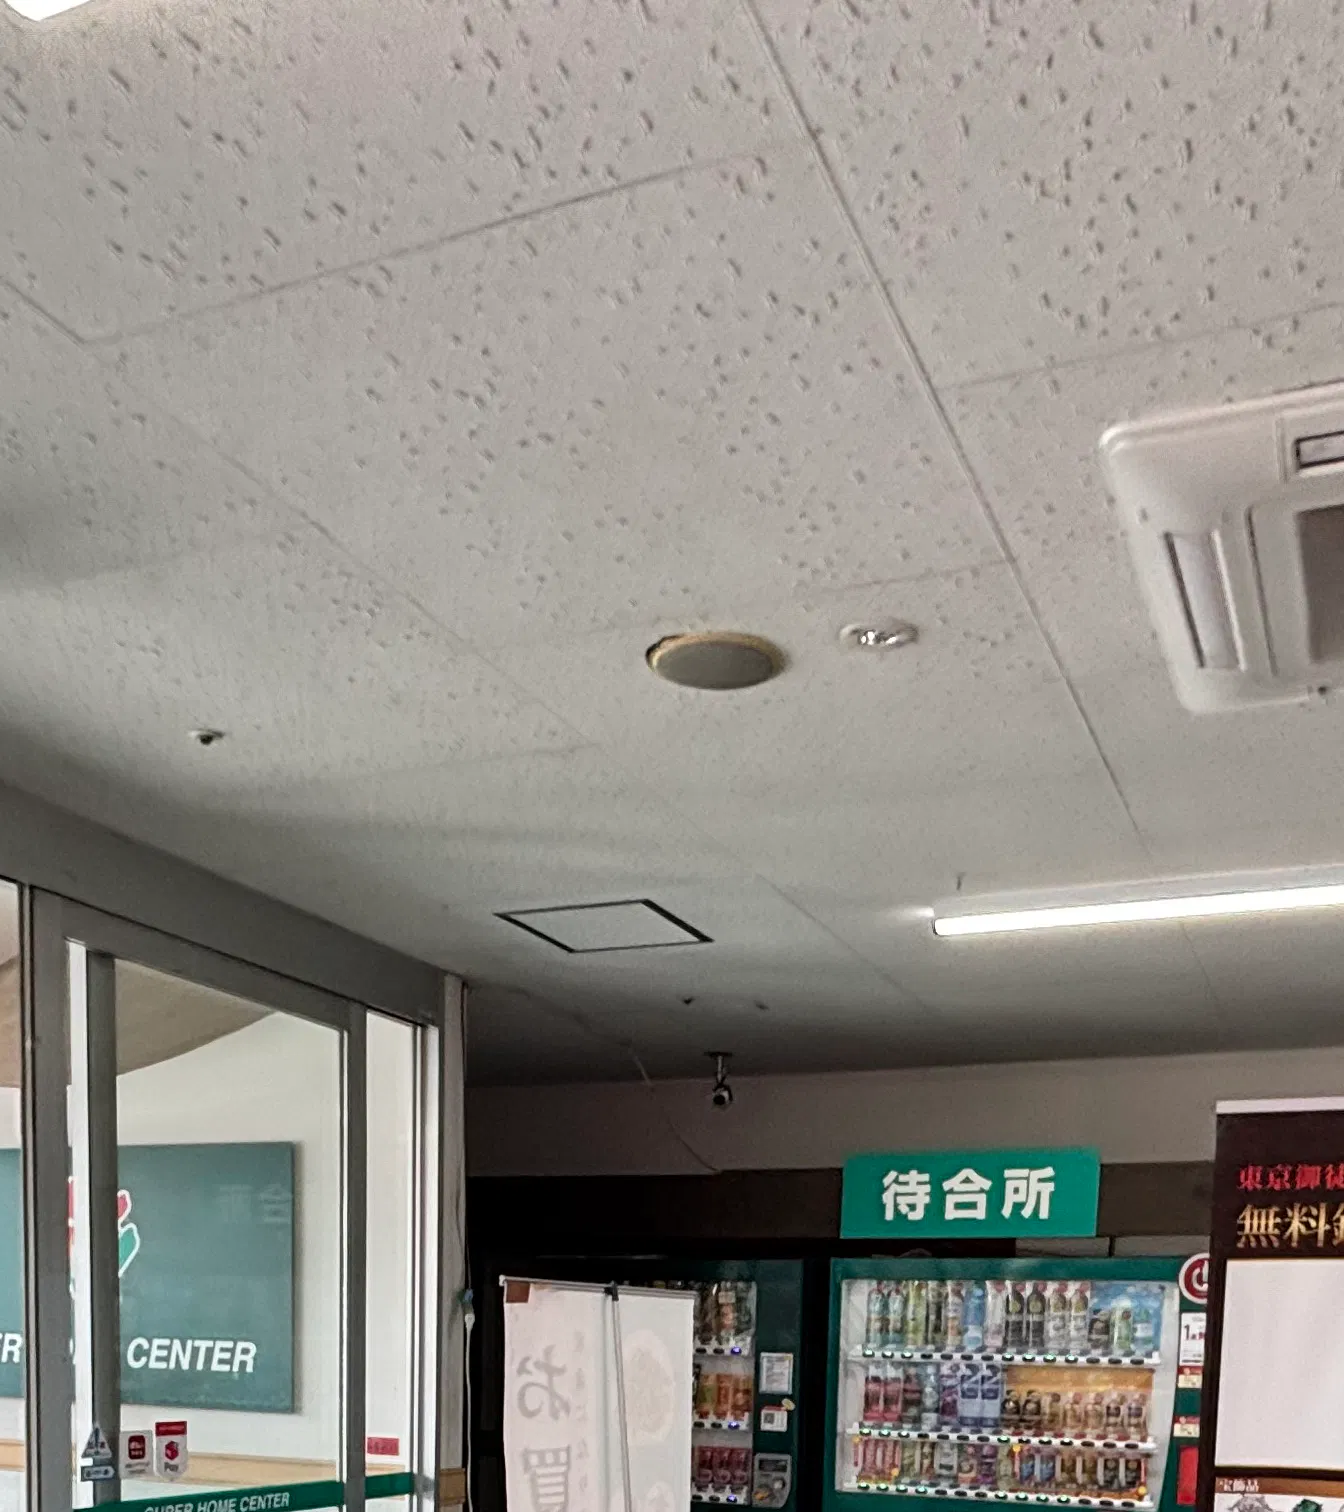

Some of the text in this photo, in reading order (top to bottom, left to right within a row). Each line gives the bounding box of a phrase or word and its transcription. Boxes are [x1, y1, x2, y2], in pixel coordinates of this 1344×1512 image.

[882, 1166, 1055, 1221] 待合所
[126, 1336, 256, 1373] CENTER
